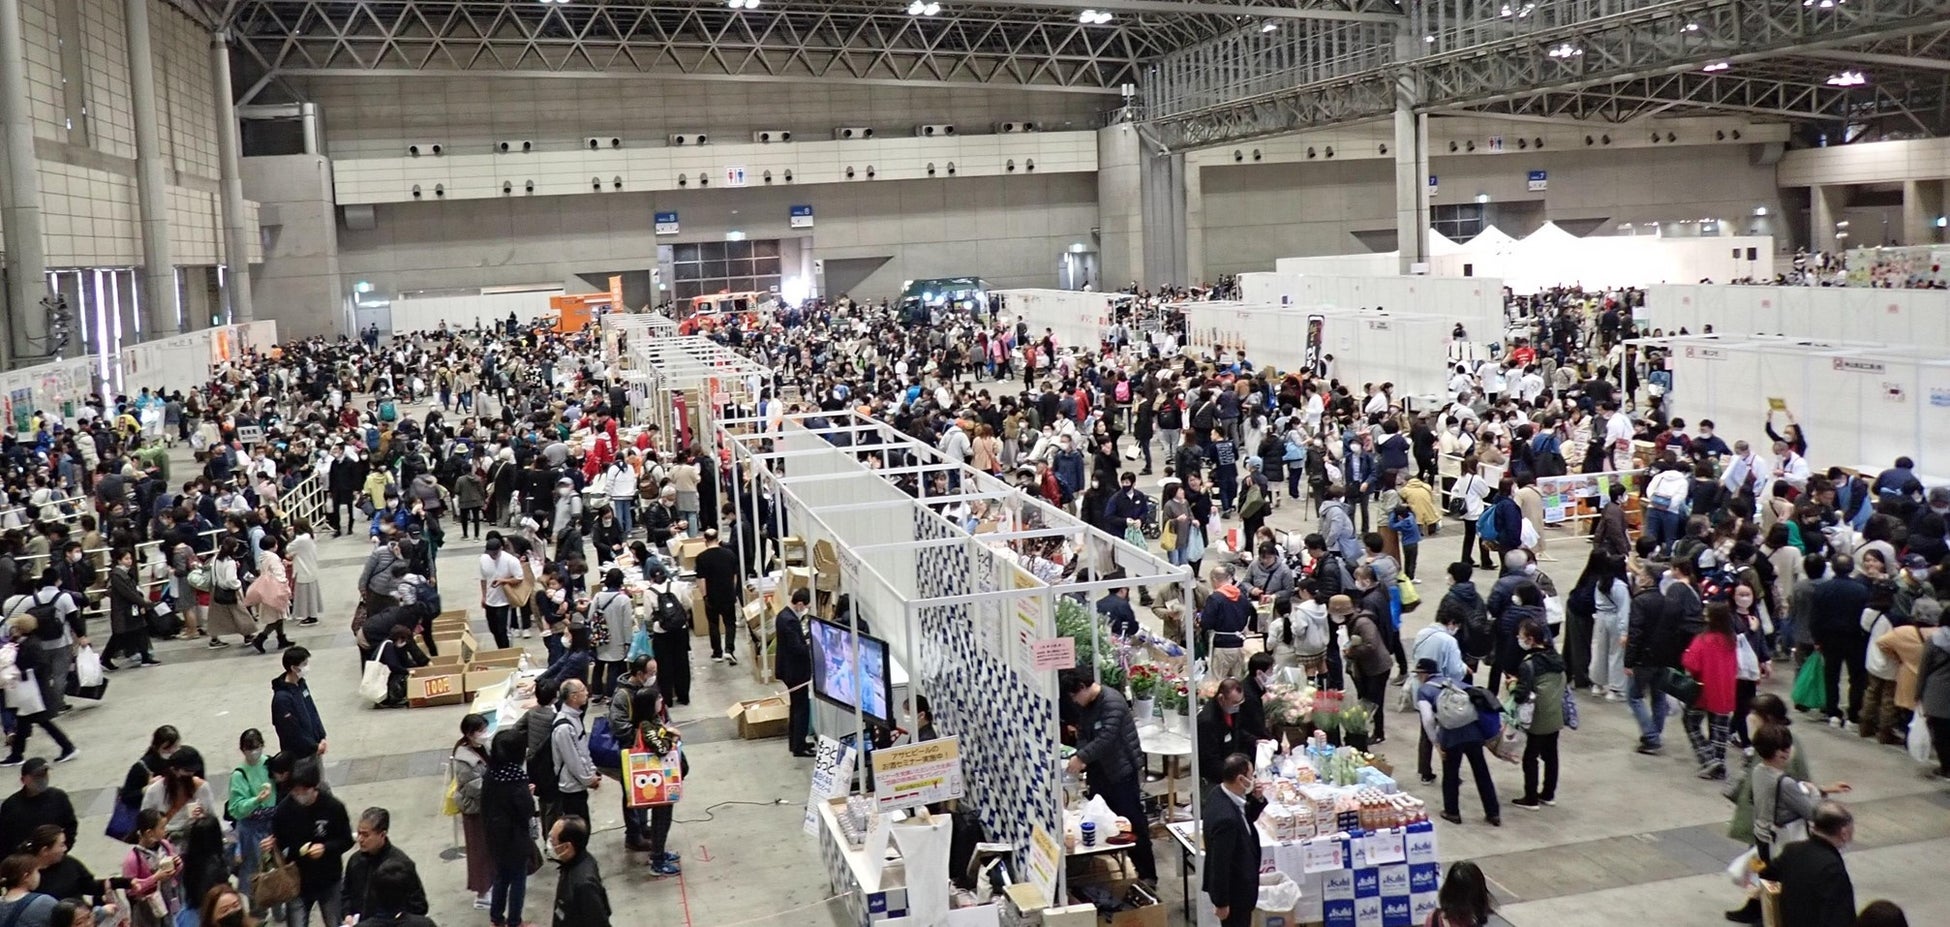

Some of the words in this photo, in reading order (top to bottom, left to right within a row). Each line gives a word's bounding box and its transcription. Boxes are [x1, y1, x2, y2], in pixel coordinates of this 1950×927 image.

[818, 740, 838, 760] もっと
[891, 745, 939, 760] アサヒビールの
[816, 755, 837, 776] もっと
[1410, 841, 1432, 851] Asahi
[1327, 877, 1350, 888] Asahi
[1357, 875, 1376, 887] Asahi
[1383, 873, 1406, 884] Asahi
[1328, 907, 1352, 918] Asahi
[1359, 905, 1378, 917] Asahi
[1384, 903, 1408, 914] Asahi
